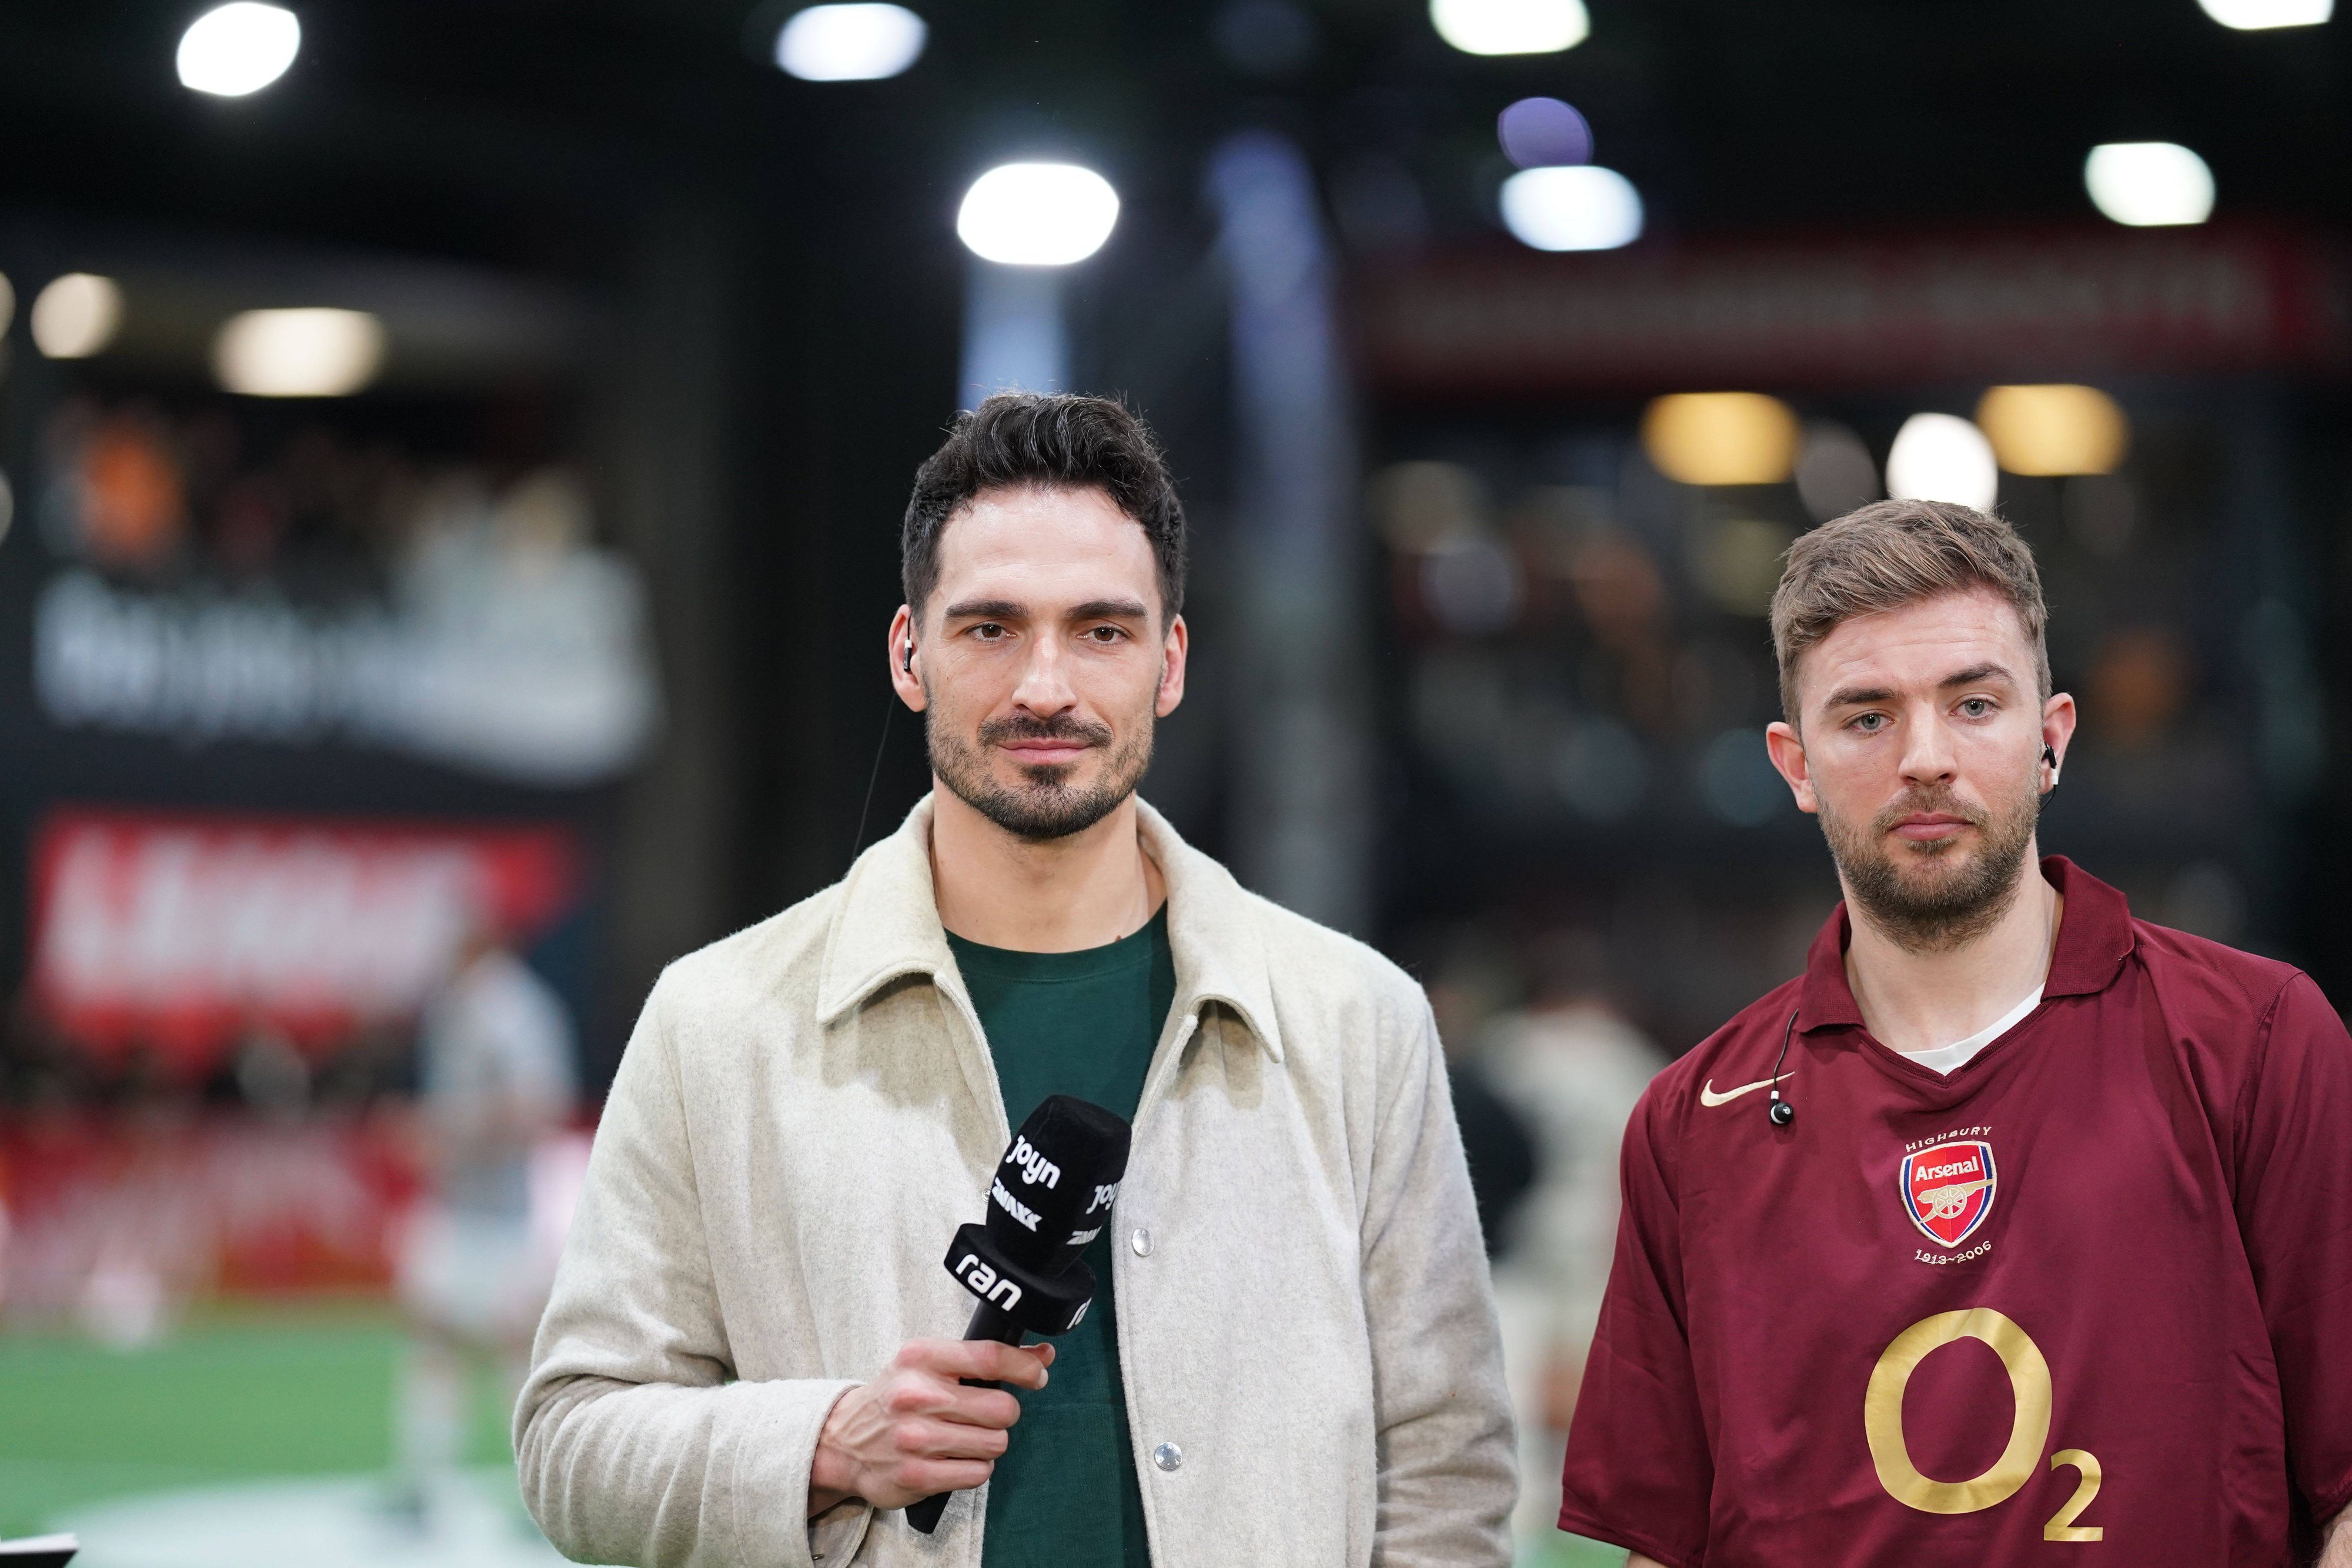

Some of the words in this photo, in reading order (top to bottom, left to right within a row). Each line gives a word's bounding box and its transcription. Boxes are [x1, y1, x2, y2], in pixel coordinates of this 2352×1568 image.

[1905, 1126, 1992, 1152] HIGHBURY
[1005, 1134, 1061, 1190] joyn
[1915, 1155, 1980, 1182] Arsenal
[1085, 1181, 1120, 1215] joy
[955, 1253, 1023, 1312] ran
[1865, 1307, 2103, 1542] O2
